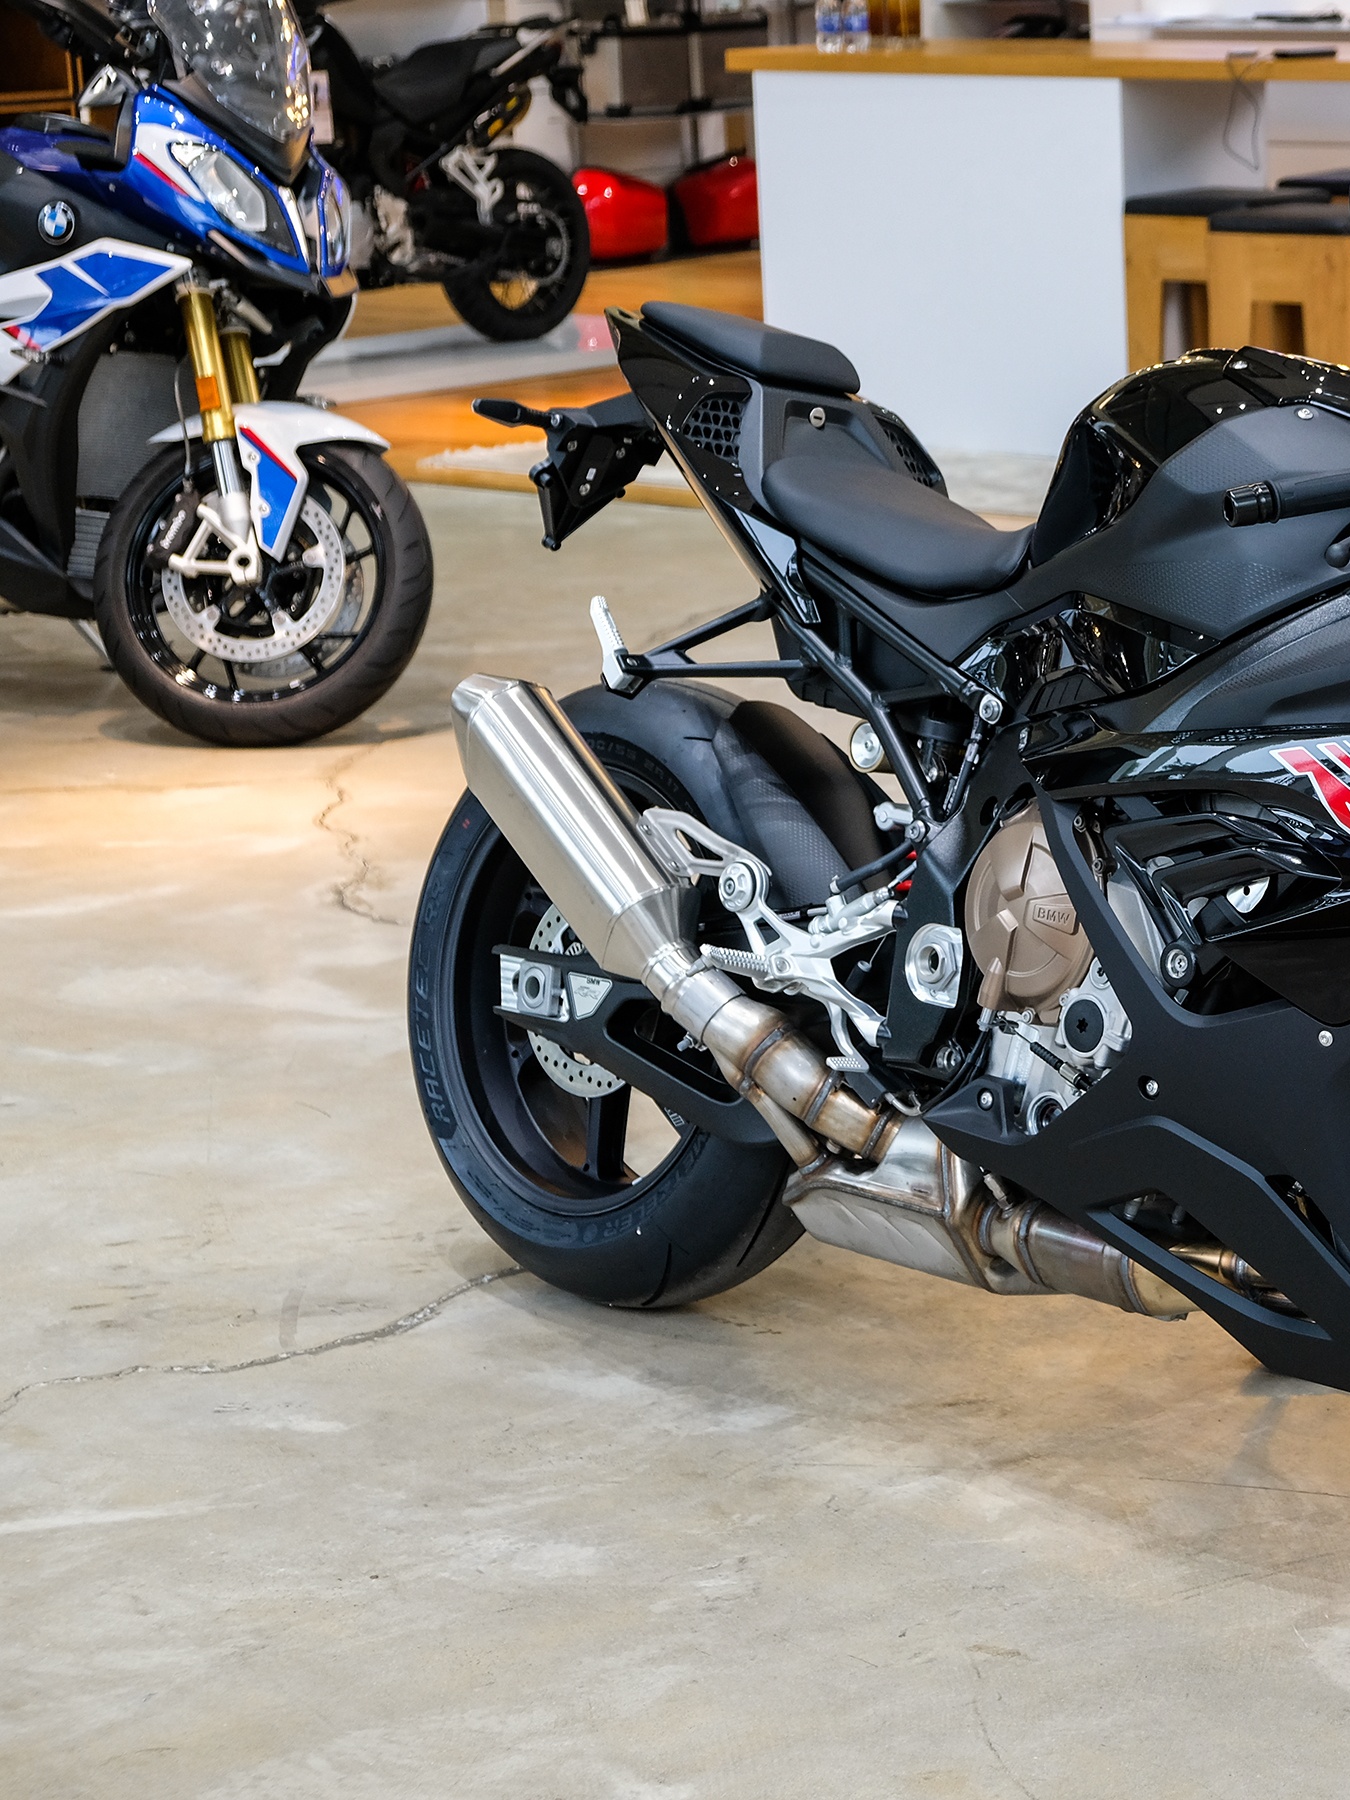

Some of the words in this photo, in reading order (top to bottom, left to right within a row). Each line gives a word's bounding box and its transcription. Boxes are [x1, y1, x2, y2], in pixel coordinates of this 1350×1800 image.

[159, 509, 186, 550] brembo
[1037, 906, 1071, 925] BMW
[585, 976, 602, 987] BMW
[414, 943, 452, 1124] RACETEC
